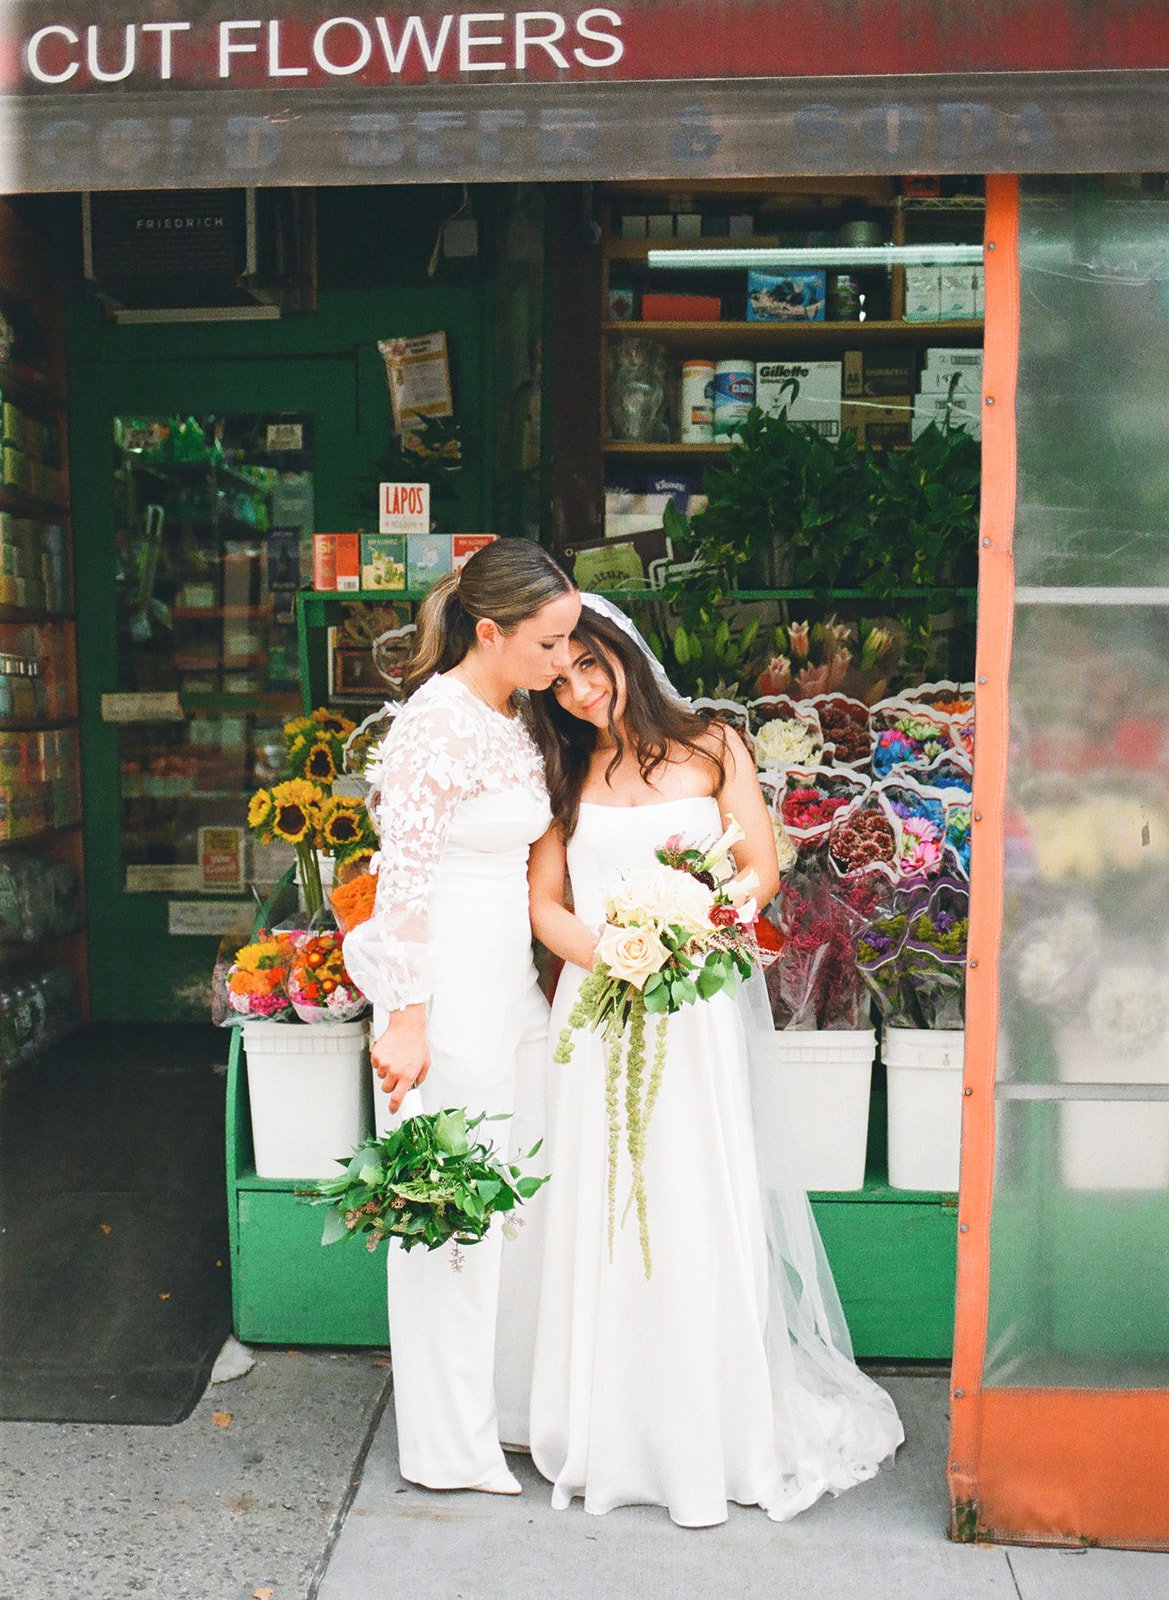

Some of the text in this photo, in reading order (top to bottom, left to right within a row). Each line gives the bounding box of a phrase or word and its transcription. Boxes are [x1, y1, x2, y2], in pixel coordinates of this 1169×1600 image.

[26, 8, 625, 84] CUT FLOWERS
[136, 217, 224, 230] FRIEDRICH
[760, 365, 809, 378] Gillette
[386, 486, 424, 514] LAPOS
